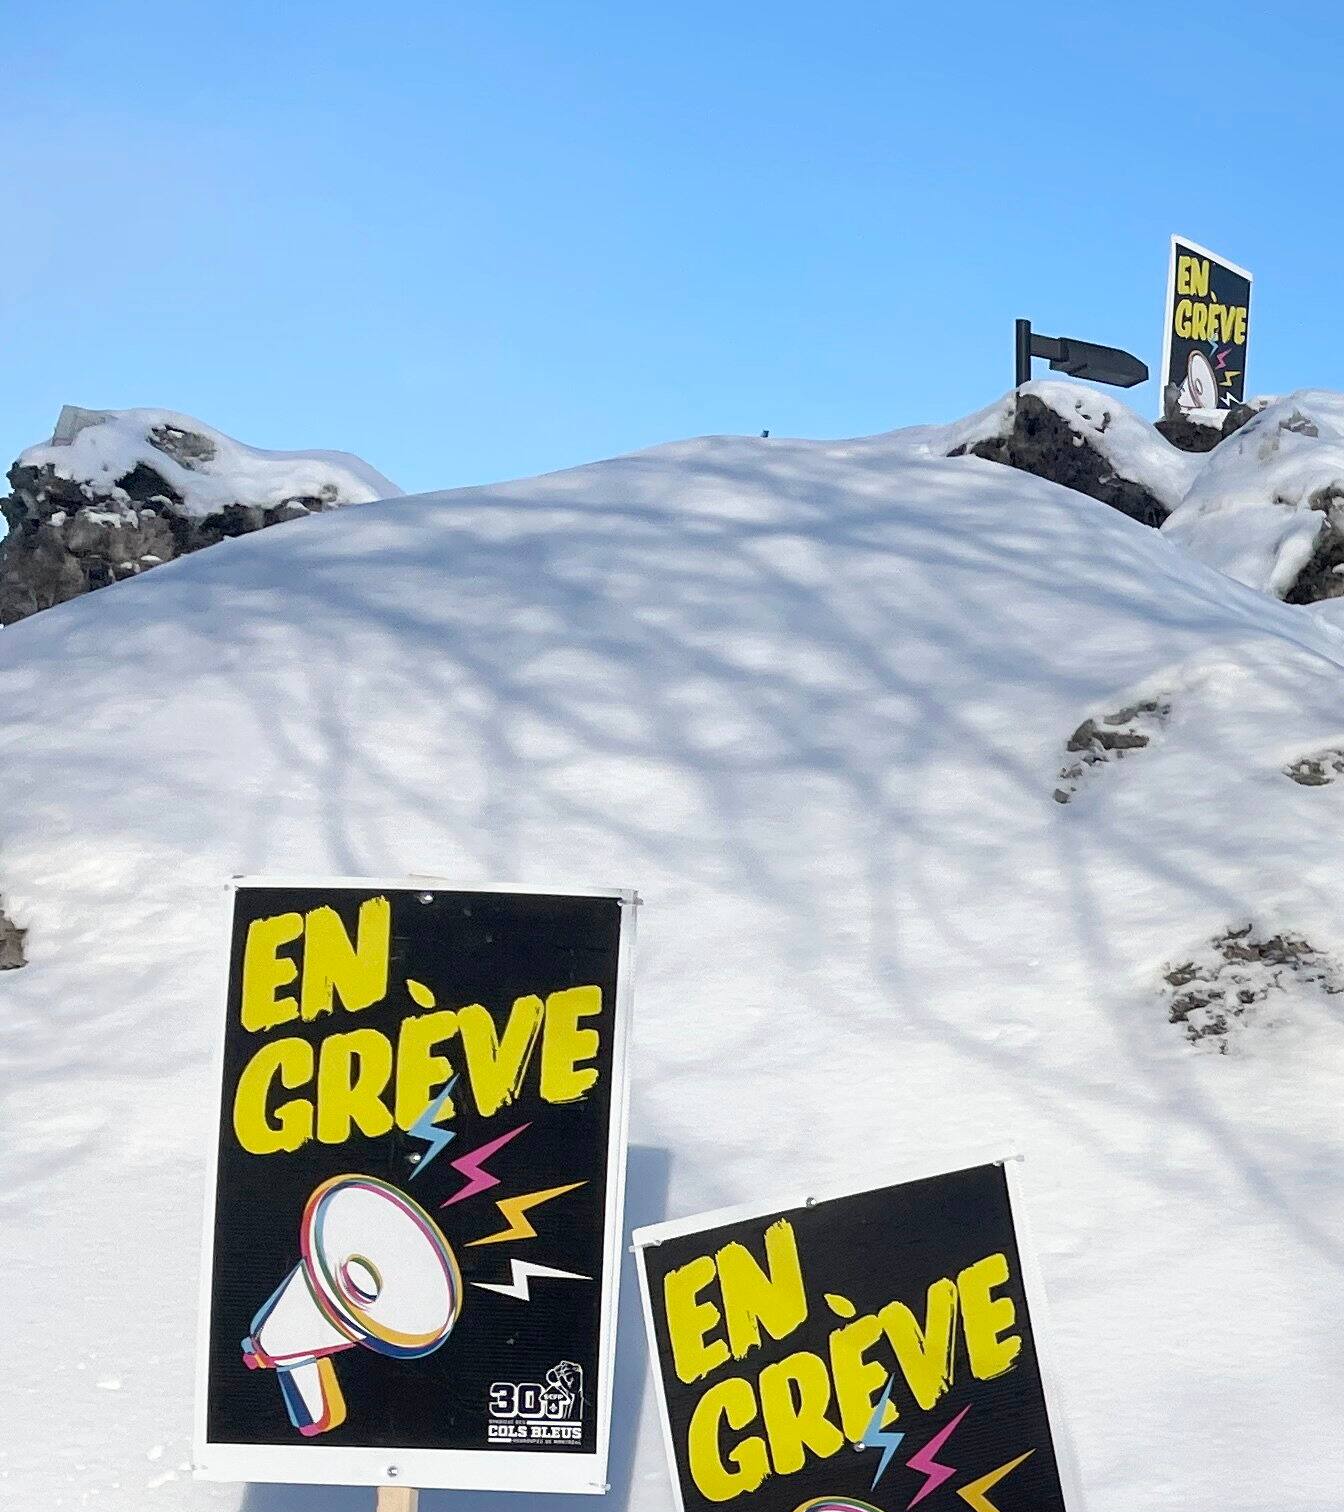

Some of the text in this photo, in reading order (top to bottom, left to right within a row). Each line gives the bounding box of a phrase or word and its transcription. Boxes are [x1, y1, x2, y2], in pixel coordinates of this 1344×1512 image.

[1175, 291, 1246, 345] GRÈVE
[1177, 256, 1210, 298] EN
[241, 896, 390, 1033] EN
[233, 979, 602, 1155] GRÈVE
[664, 1218, 808, 1385] EN
[488, 1425, 582, 1439] COLS BLEUS
[688, 1253, 1022, 1502] GRÈVE
